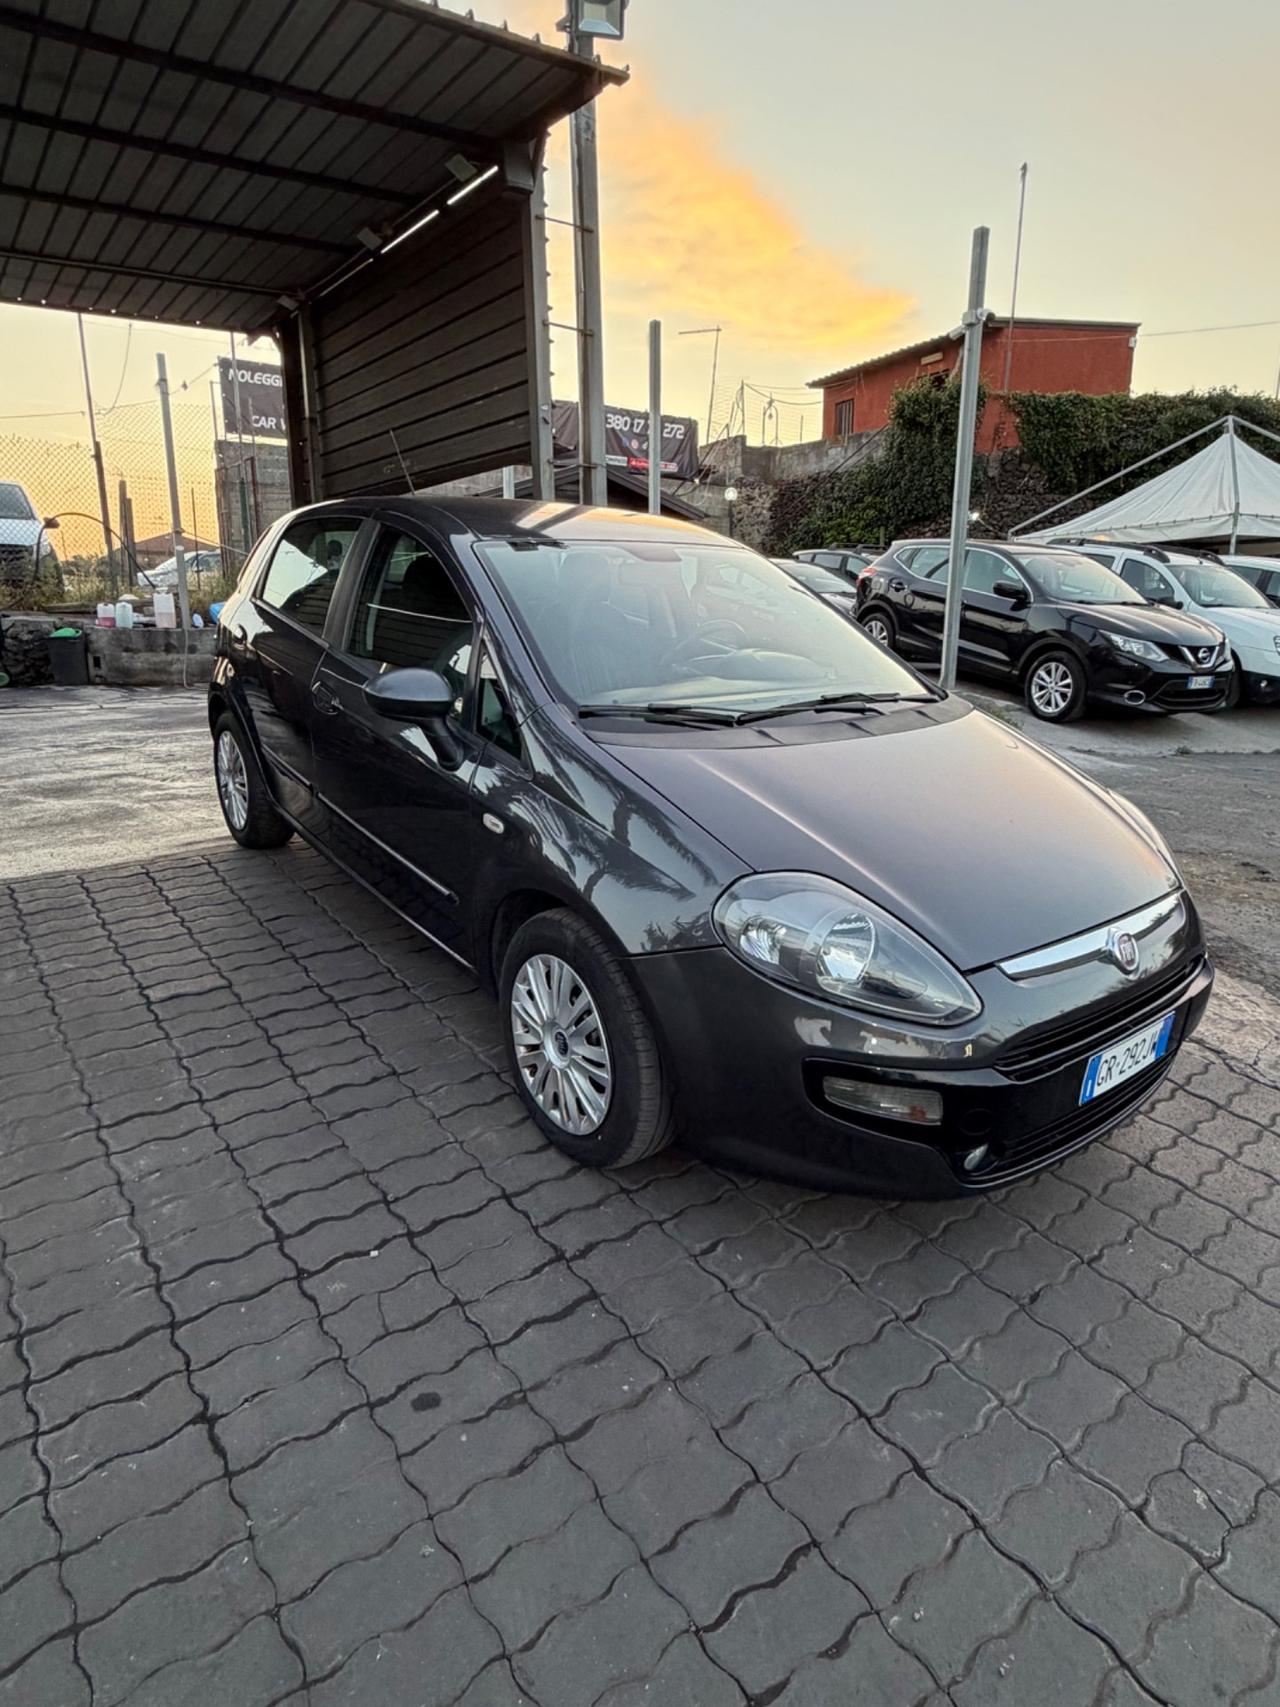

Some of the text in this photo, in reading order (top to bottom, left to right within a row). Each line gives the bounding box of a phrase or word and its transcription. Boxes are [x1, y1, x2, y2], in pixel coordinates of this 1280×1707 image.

[251, 415, 277, 430] CAR
[605, 413, 631, 432] 380
[663, 422, 685, 439] 272
